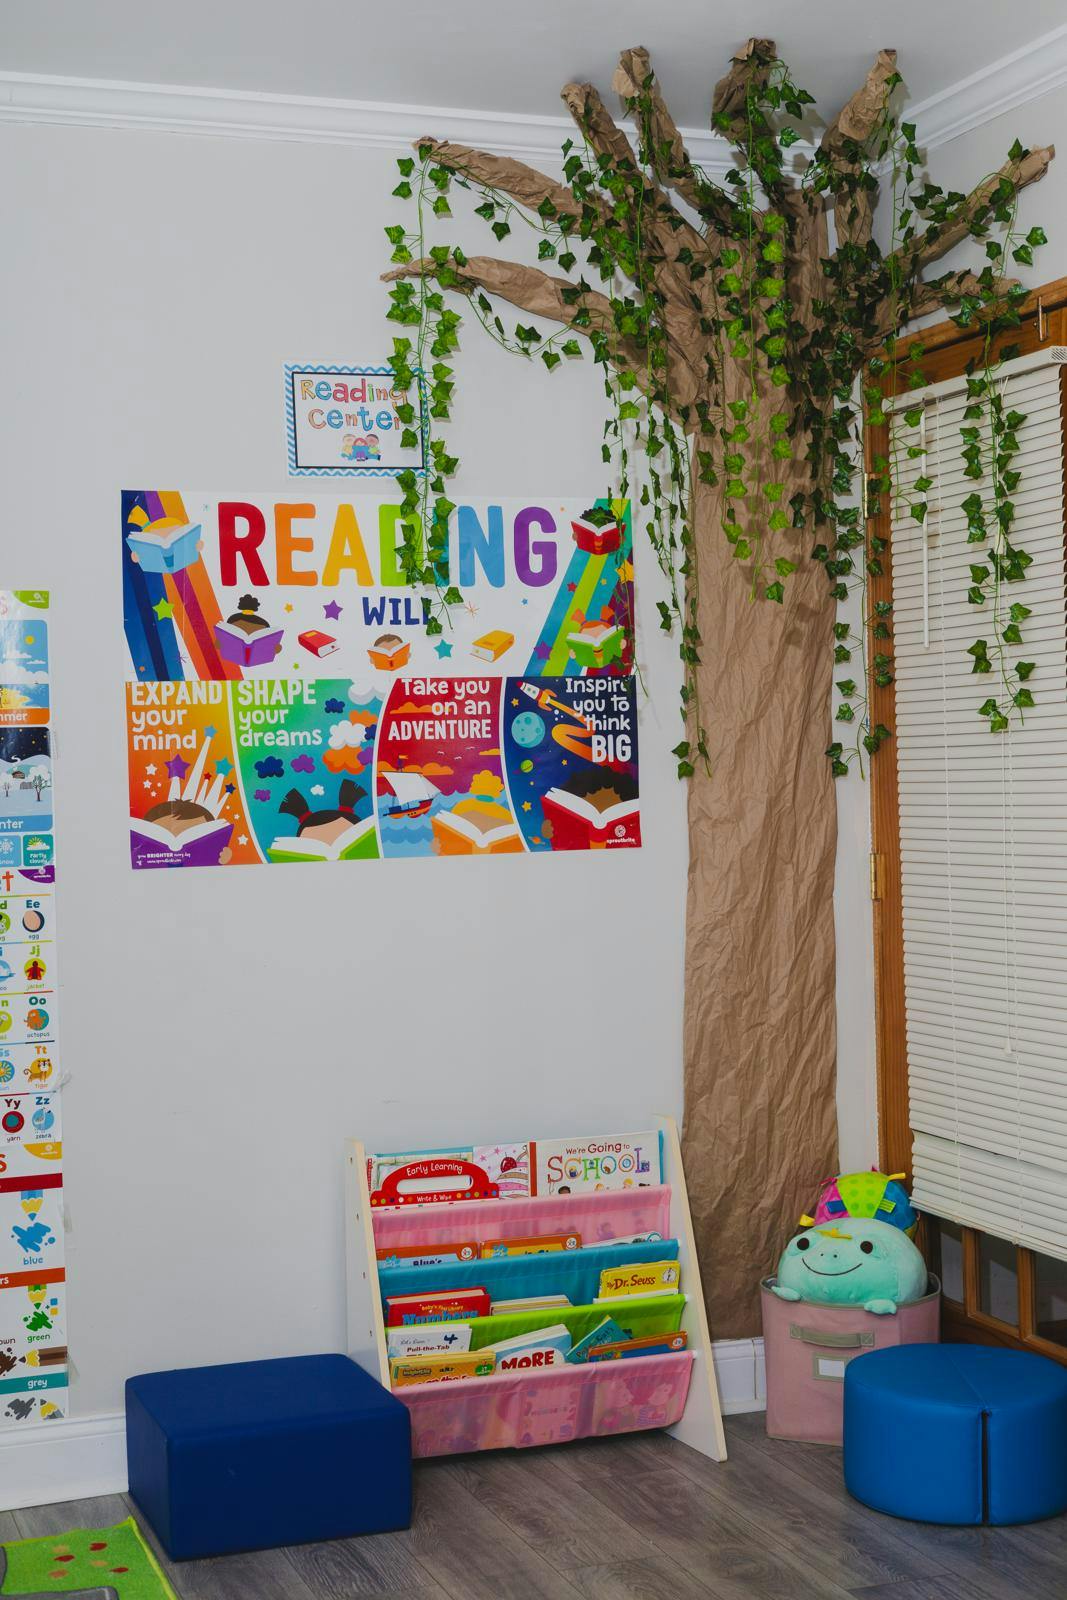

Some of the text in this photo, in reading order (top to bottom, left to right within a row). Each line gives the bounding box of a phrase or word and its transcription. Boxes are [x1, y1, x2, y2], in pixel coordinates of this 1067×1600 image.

[300, 378, 407, 408] Reading
[218, 502, 557, 588] READNG
[132, 681, 223, 706] EXPAND
[238, 680, 316, 706] SHAPE
[401, 678, 490, 700] Take you
[432, 700, 491, 715] on an
[573, 700, 605, 717] you
[132, 709, 187, 732] your
[239, 709, 288, 730] your
[584, 714, 631, 731] think
[240, 729, 322, 747] dreams
[388, 719, 492, 740] ADVENTURE
[133, 729, 196, 750] mind
[592, 734, 631, 762] BIG
[26, 900, 40, 908] Ee
[30, 945, 40, 957] Jj
[29, 996, 46, 1005] Oo
[35, 1046, 47, 1054] Tt
[5, 1099, 20, 1110] Yy
[36, 1097, 50, 1105] Zz
[588, 1142, 621, 1153] Going
[407, 1162, 463, 1176] Early Learning
[547, 1148, 649, 1183] SCHOOL
[23, 1256, 44, 1265] blue
[630, 1274, 656, 1286] Seuss
[27, 1334, 50, 1343] green
[501, 1350, 555, 1370] MORE
[27, 1379, 48, 1388] grey
